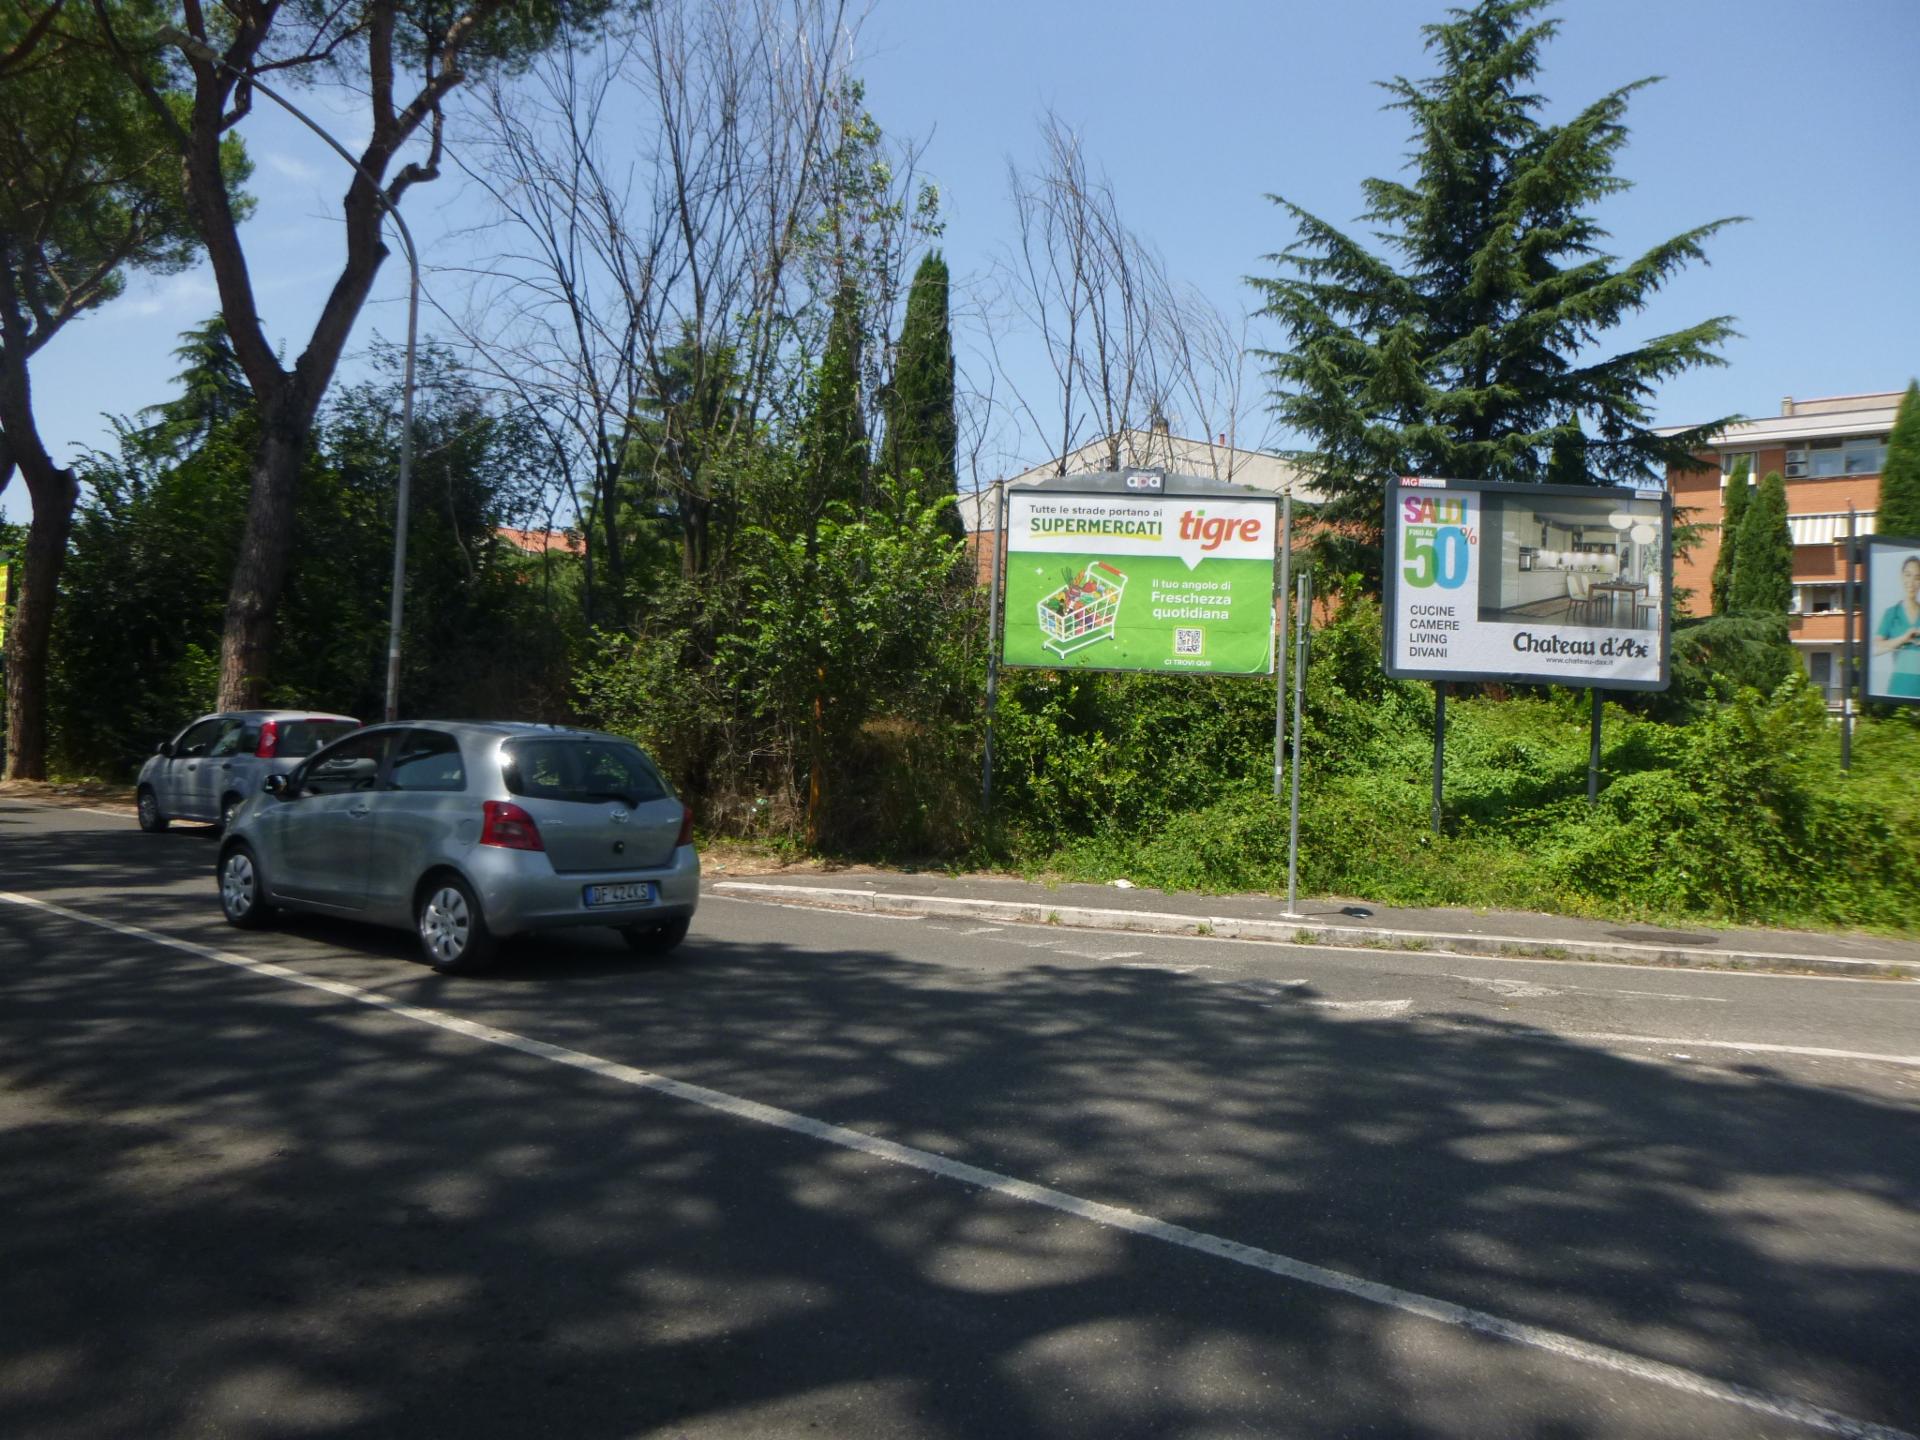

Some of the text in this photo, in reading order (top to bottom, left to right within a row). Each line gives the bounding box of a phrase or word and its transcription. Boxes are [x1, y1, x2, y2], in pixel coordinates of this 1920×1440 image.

[1030, 505, 1163, 519] Tutte le strade portano ai
[1404, 496, 1467, 525] SALDI
[1030, 518, 1162, 535] SUPERMERCATI
[1179, 509, 1261, 550] tigre
[1152, 579, 1231, 591] Il tuo angolo di
[1151, 591, 1232, 605] Freschezza
[1153, 607, 1229, 620] quotidiana
[1410, 605, 1455, 617] CUCINE
[1410, 619, 1460, 631] CAMERE
[1410, 633, 1448, 644] LIVING
[1513, 632, 1595, 656] Chateau
[1409, 647, 1448, 658] DIVANI
